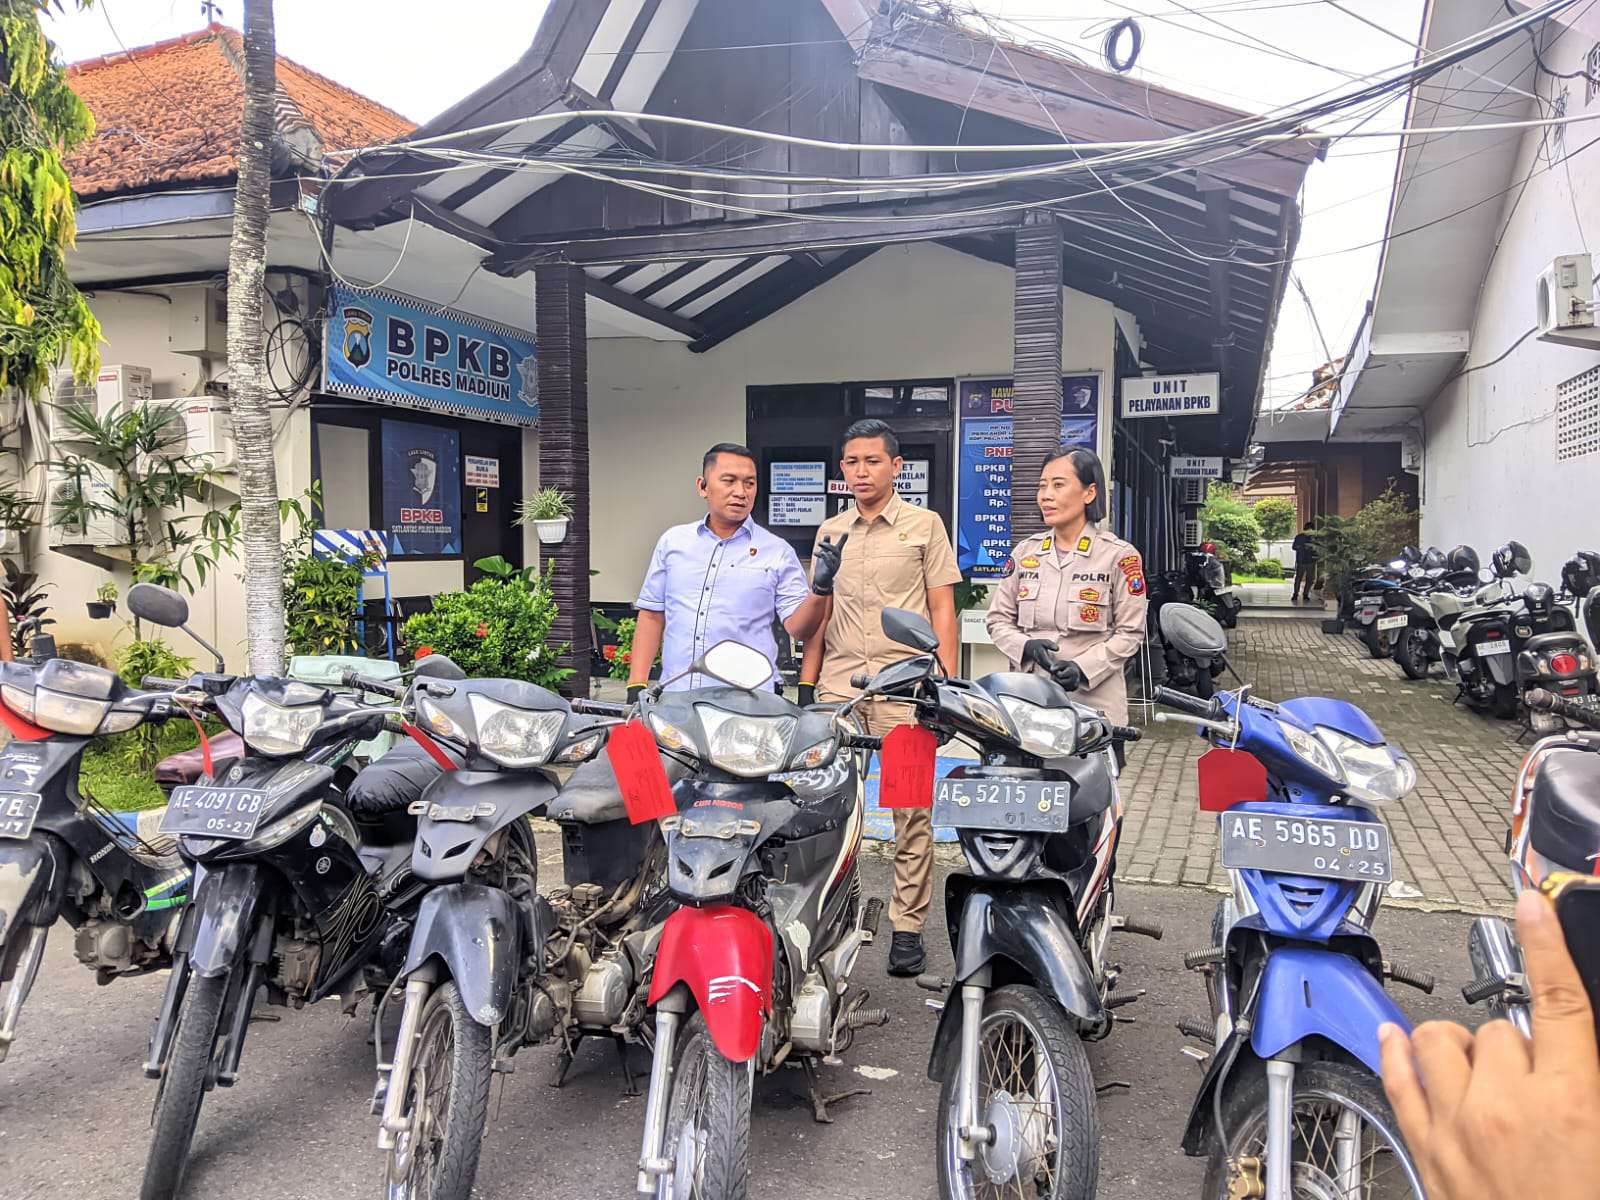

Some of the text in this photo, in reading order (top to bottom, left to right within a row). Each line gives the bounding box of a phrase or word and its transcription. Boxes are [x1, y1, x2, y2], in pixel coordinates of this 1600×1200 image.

[386, 315, 512, 382] BPKB
[386, 357, 511, 401] POLRES MADIUN
[1153, 380, 1187, 395] UNIT
[1129, 395, 1211, 412] PELAYANAN BPKB
[400, 508, 443, 524] BPKB
[1072, 573, 1110, 583] POLRI
[172, 790, 194, 809] AE
[195, 791, 235, 811] 4091
[938, 783, 1065, 806] AE 5215 CE
[1231, 818, 1380, 851] AE 5965 DD
